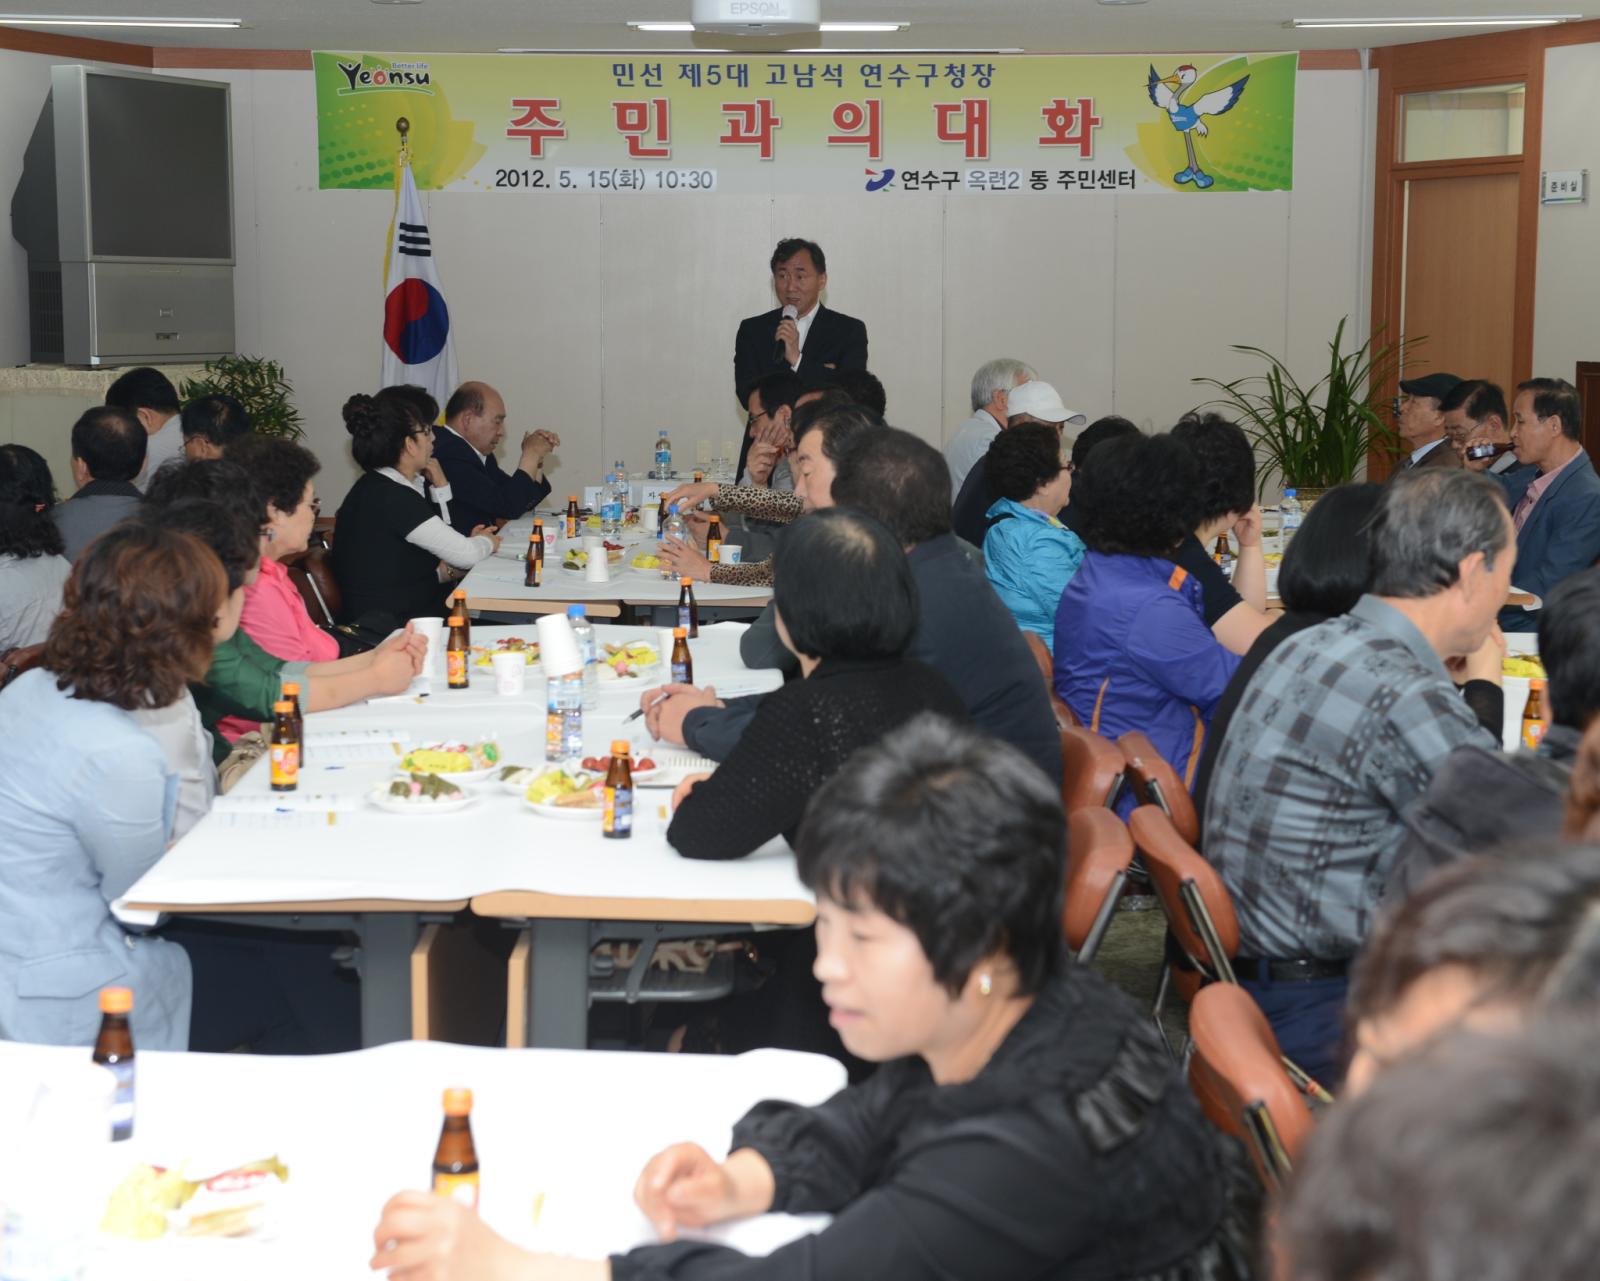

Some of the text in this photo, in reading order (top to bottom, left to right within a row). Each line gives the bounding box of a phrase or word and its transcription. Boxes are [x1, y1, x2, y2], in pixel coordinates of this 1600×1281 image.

[730, 2, 780, 15] EPSON
[337, 63, 430, 90] Yeonsu
[612, 63, 996, 89] 민선 제5대 고남석 연수구청장
[495, 169, 713, 191] 2012. 5. 15(화) 10:30
[900, 170, 961, 191] 연수구
[967, 170, 1020, 191] 옥련2
[1056, 169, 1136, 191] 주민센터
